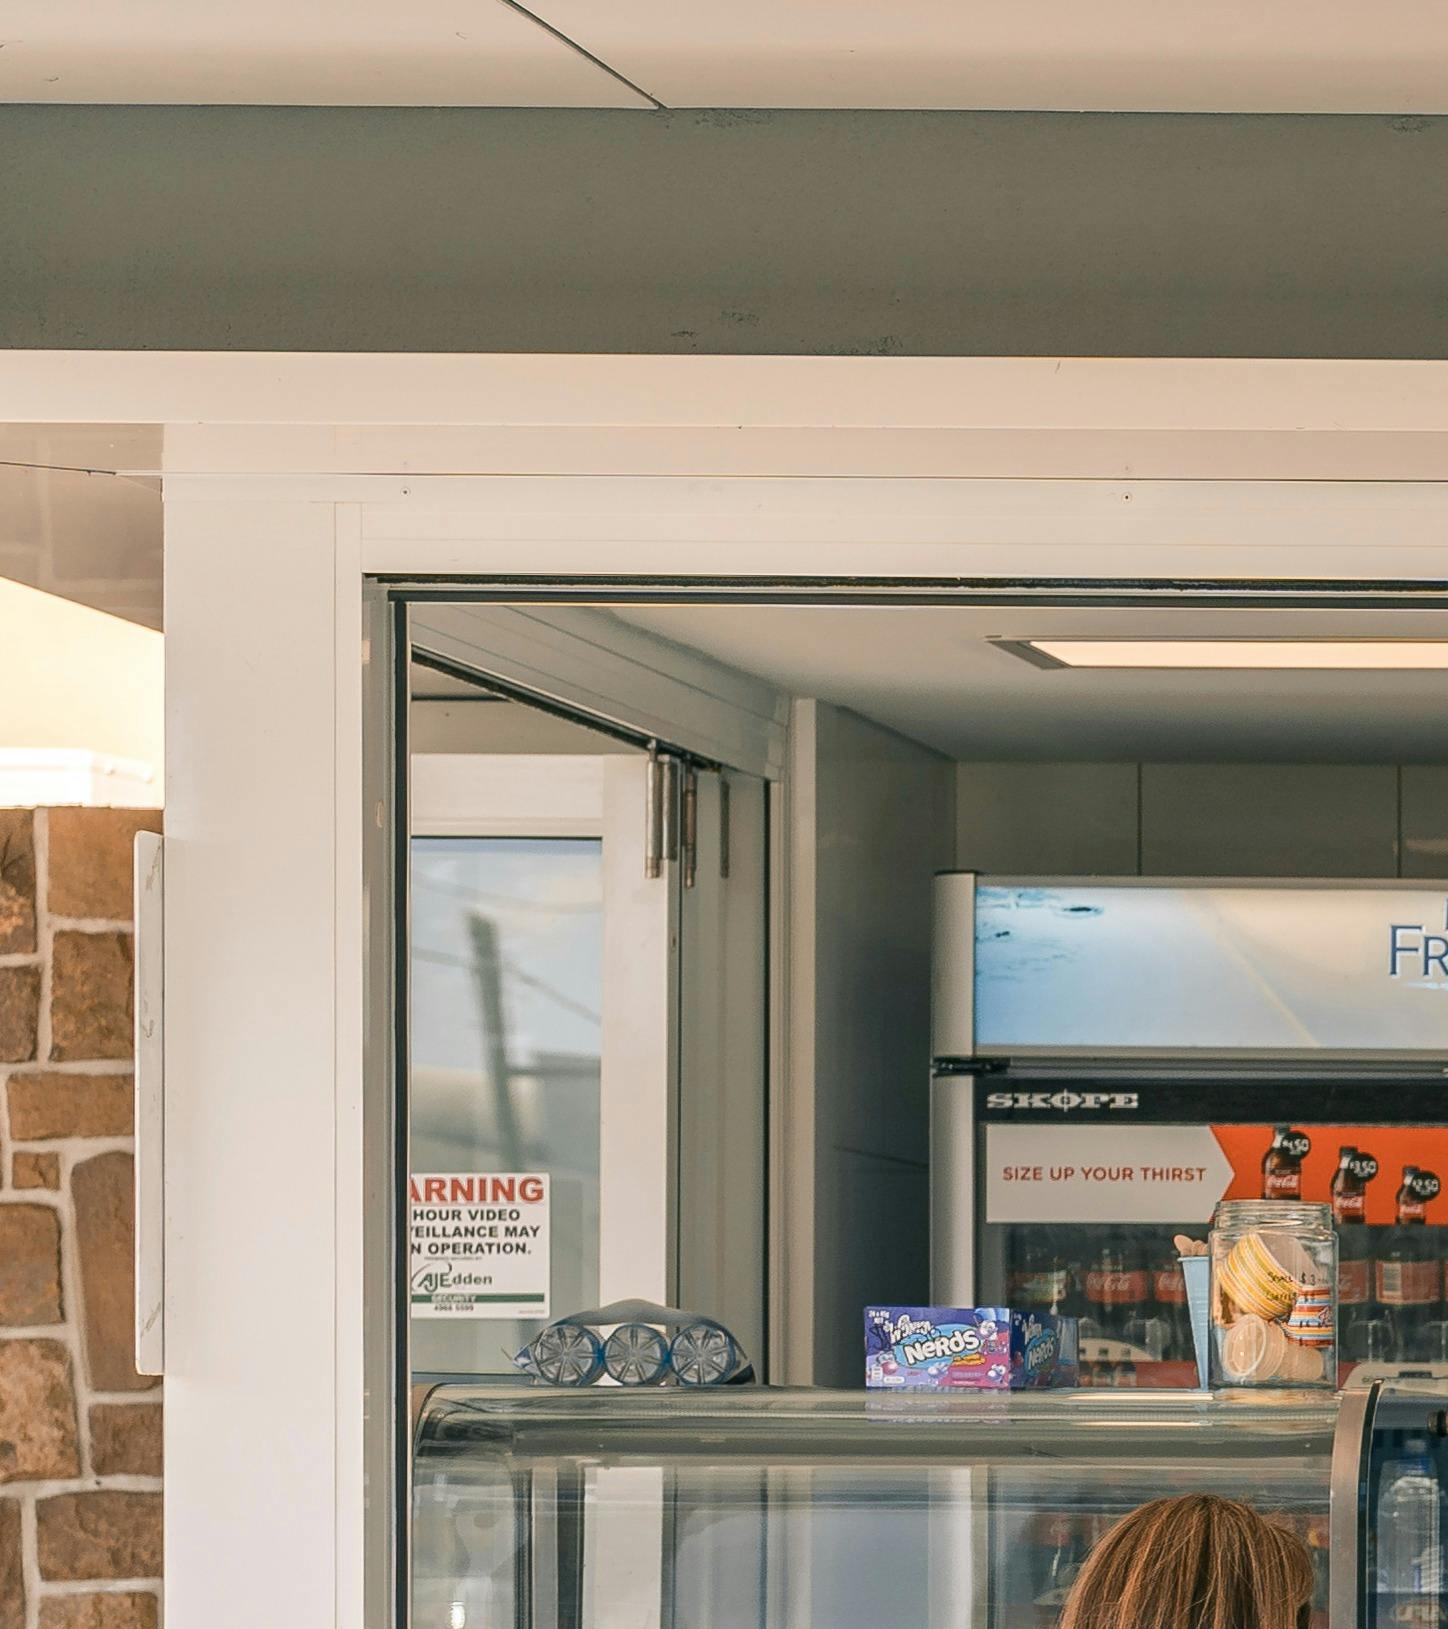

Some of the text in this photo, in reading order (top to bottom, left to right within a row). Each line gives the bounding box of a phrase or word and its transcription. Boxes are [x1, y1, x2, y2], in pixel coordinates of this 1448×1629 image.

[986, 1088, 1139, 1113] SKOPE
[1003, 1167, 1208, 1182] SIZE UP YOUR THIRST
[413, 1209, 521, 1221] HOUR VIDEO
[505, 1226, 541, 1238] MAY
[428, 1242, 532, 1255] OPERATION.
